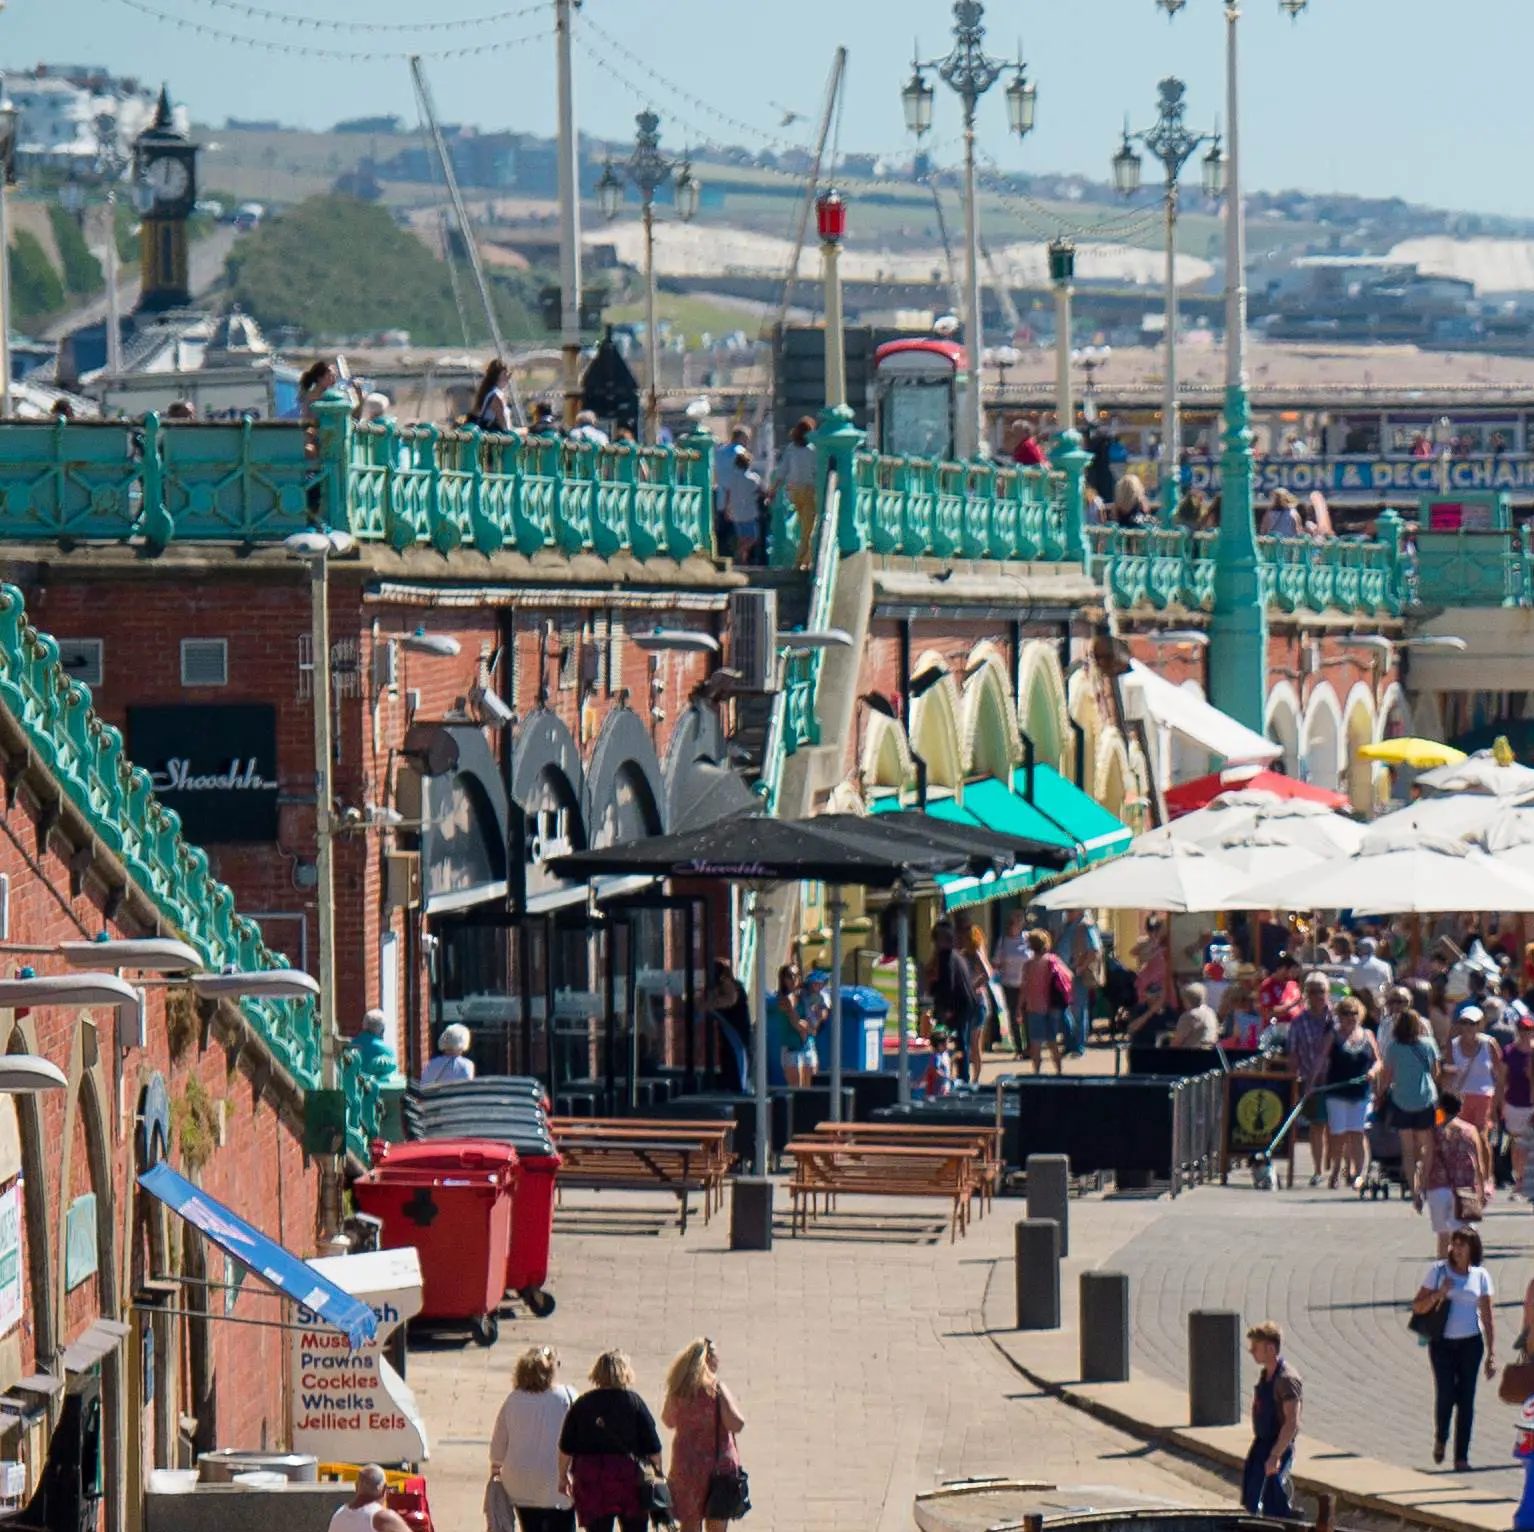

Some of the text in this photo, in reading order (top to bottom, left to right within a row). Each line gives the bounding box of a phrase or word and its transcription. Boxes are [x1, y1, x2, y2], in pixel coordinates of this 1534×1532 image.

[301, 1353, 374, 1370] Prawns
[301, 1373, 378, 1389] Cockles
[301, 1393, 375, 1410] Whelks
[297, 1413, 406, 1430] Jellied Eels
